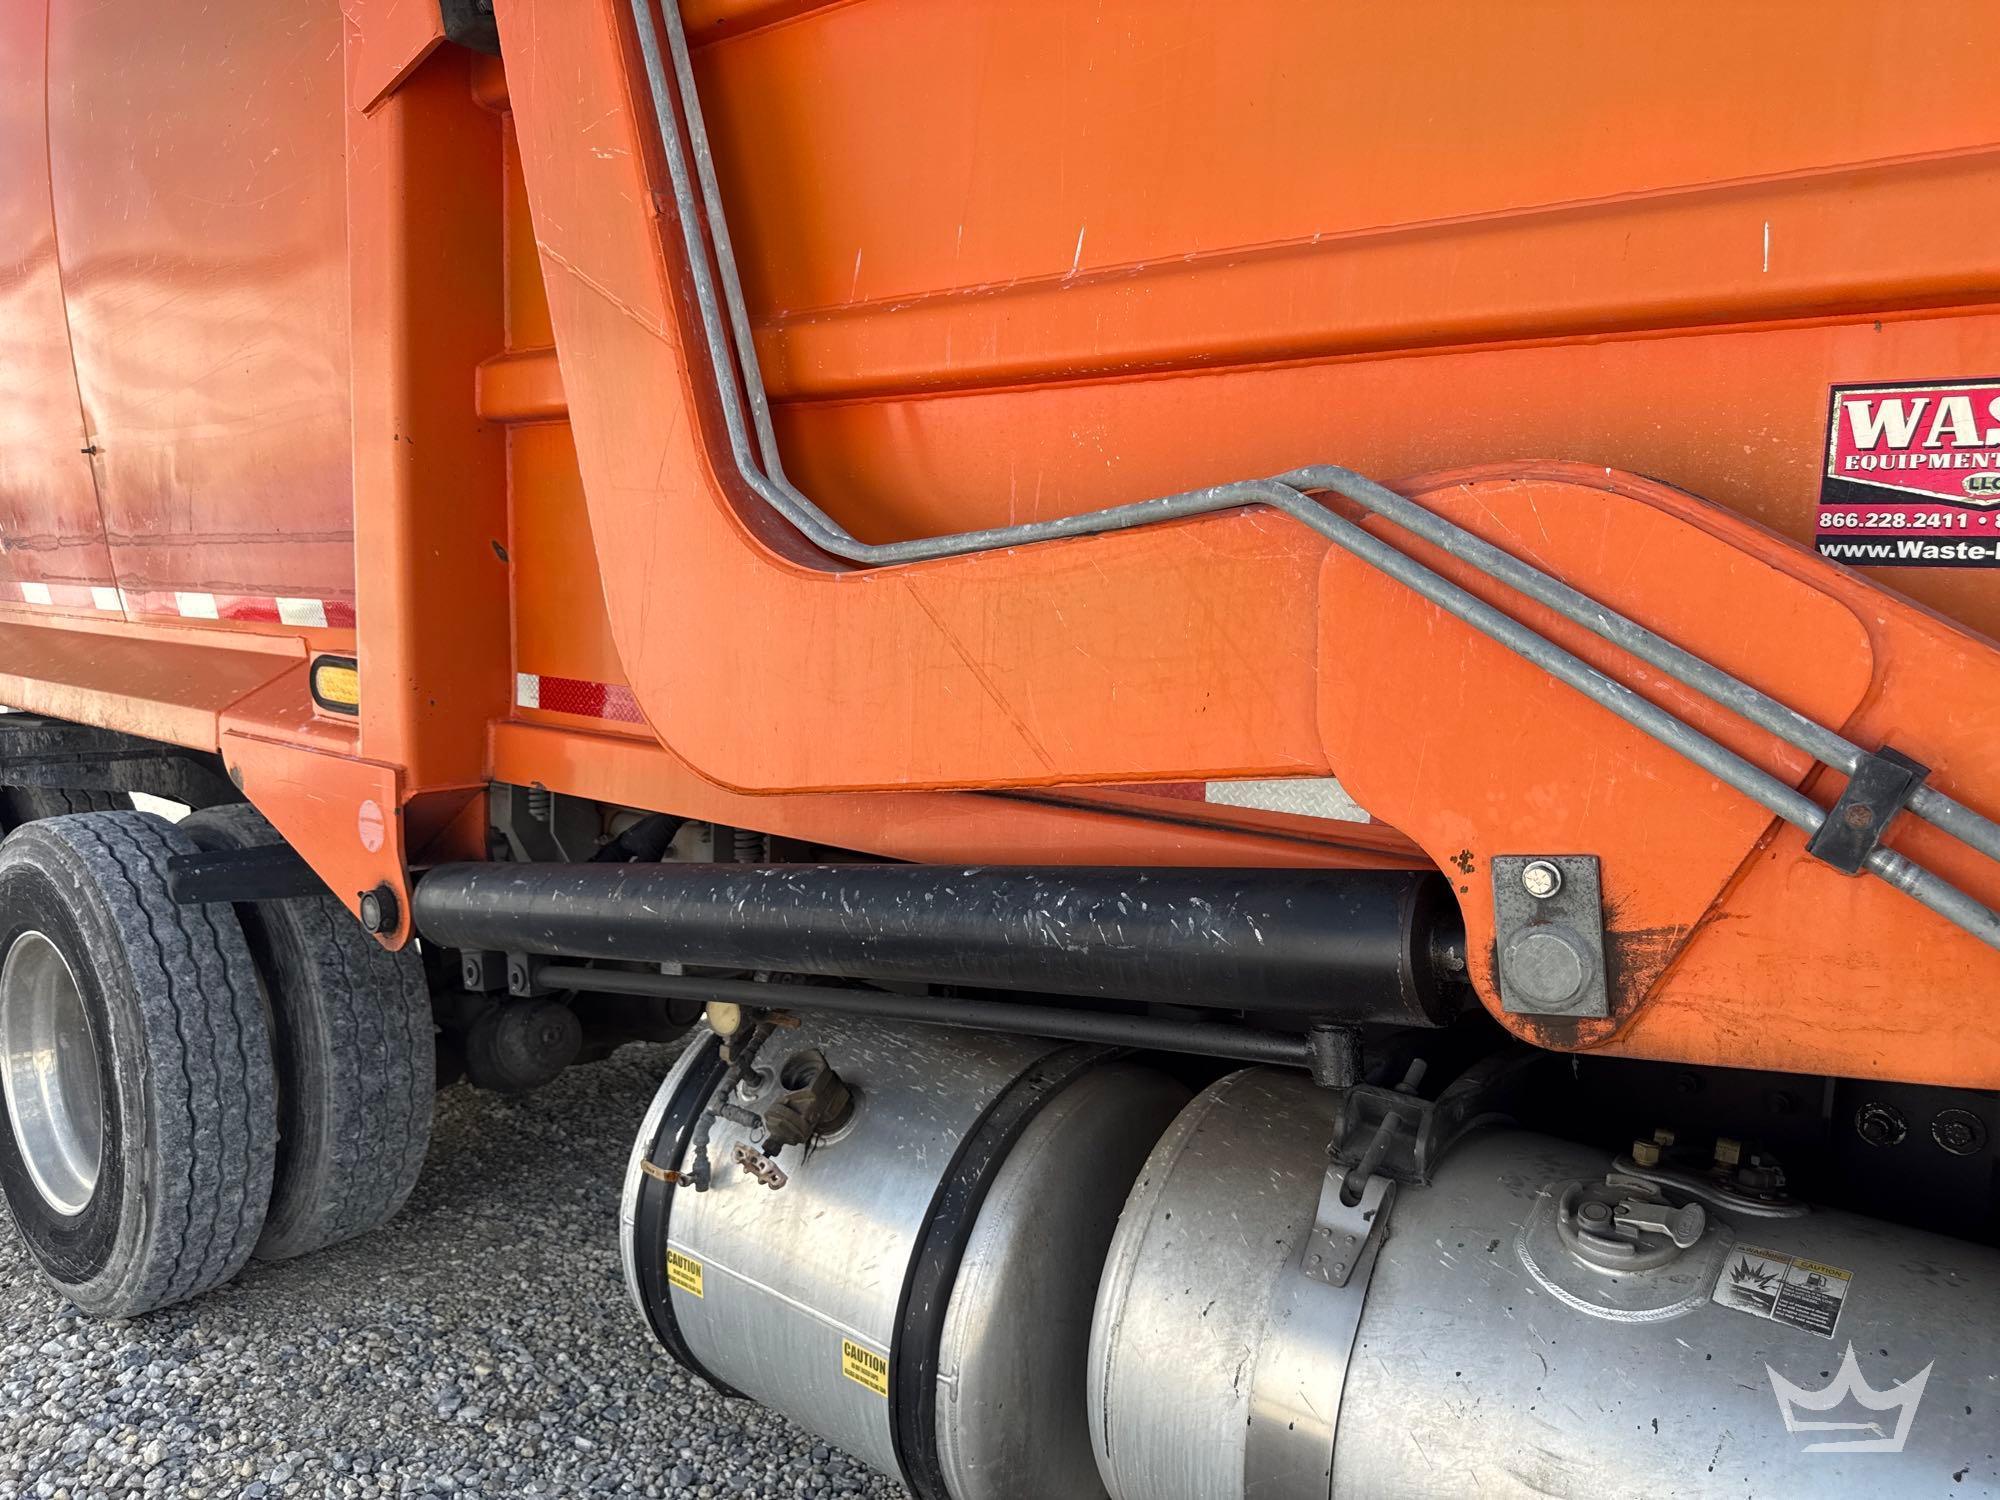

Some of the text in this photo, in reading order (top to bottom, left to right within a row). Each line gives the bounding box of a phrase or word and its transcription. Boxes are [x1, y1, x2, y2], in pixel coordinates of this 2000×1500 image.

[1969, 477, 2000, 490] LLC
[1819, 512, 1968, 529] 866.228.2411
[1819, 541, 2000, 559] www.Waste-
[667, 1251, 702, 1277] CAUTION
[1801, 1261, 1842, 1276] CAUTION
[844, 1341, 886, 1376] CAUTION
